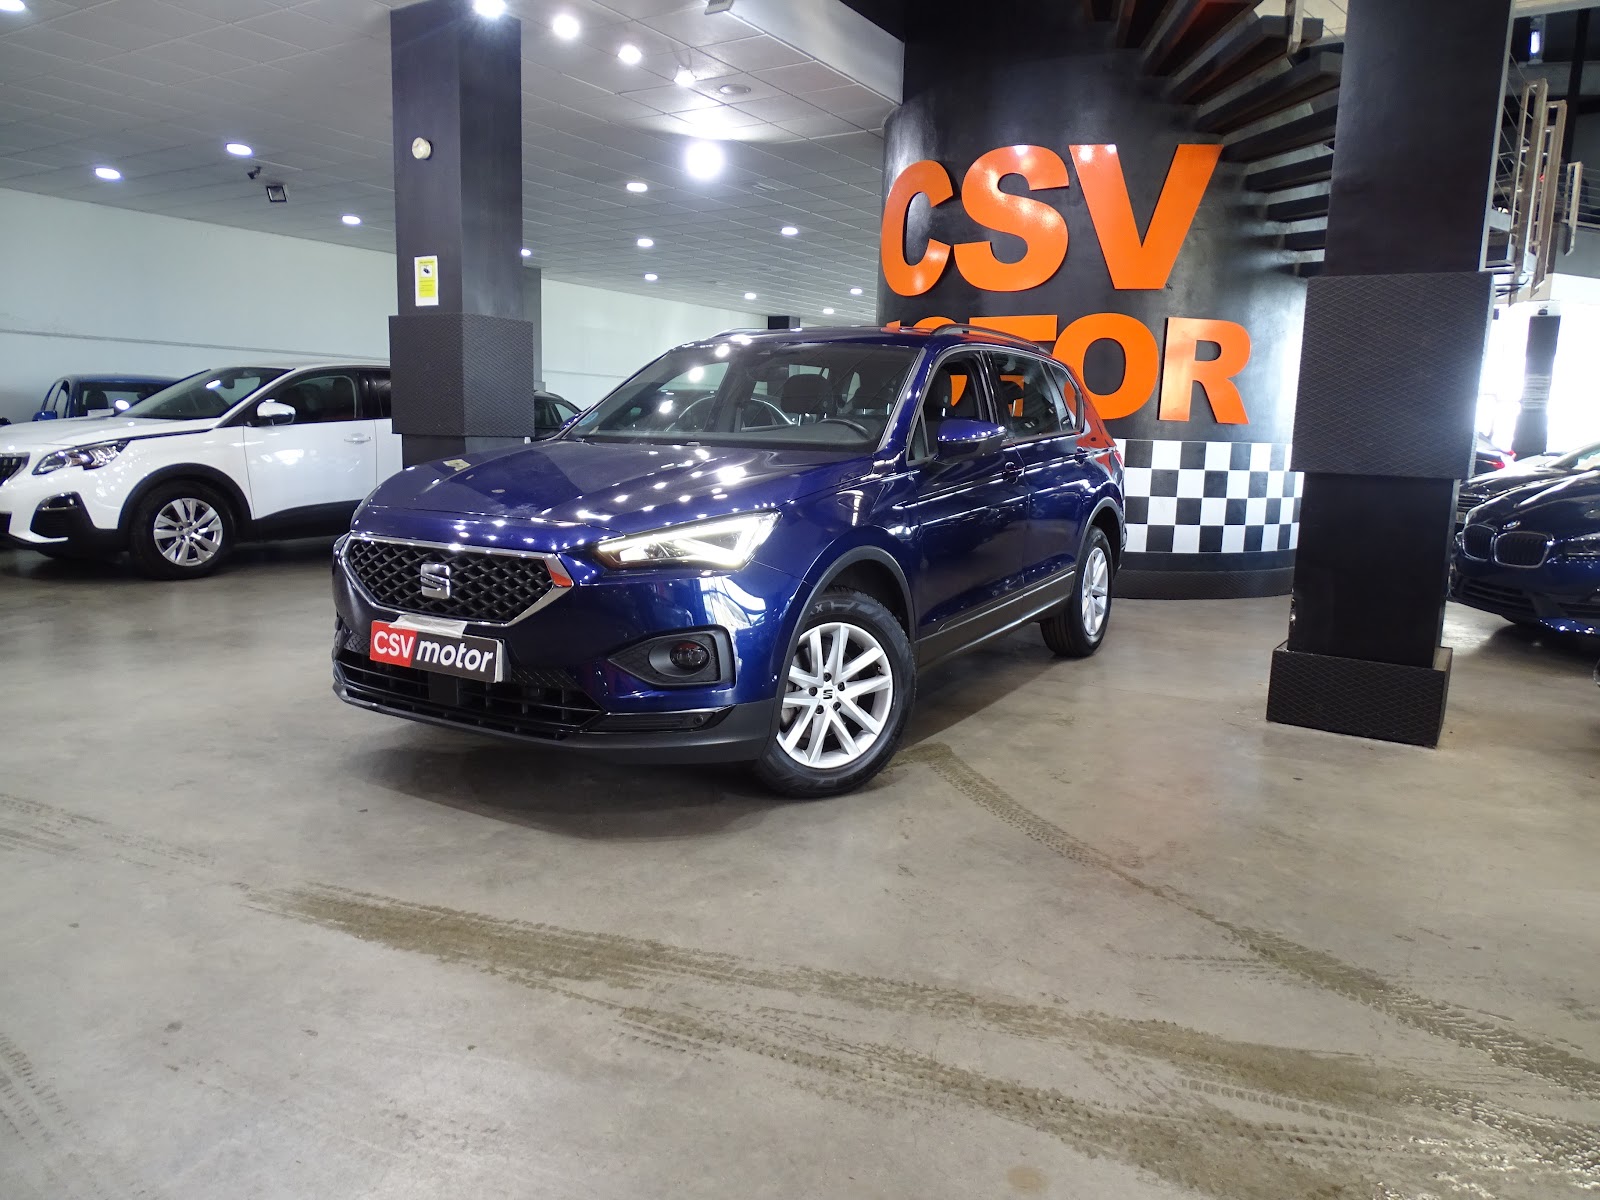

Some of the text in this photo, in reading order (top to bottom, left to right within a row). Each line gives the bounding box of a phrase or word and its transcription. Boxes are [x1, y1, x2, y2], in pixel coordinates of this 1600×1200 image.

[880, 143, 1225, 297] CSV
[373, 630, 494, 673] CSV motor
